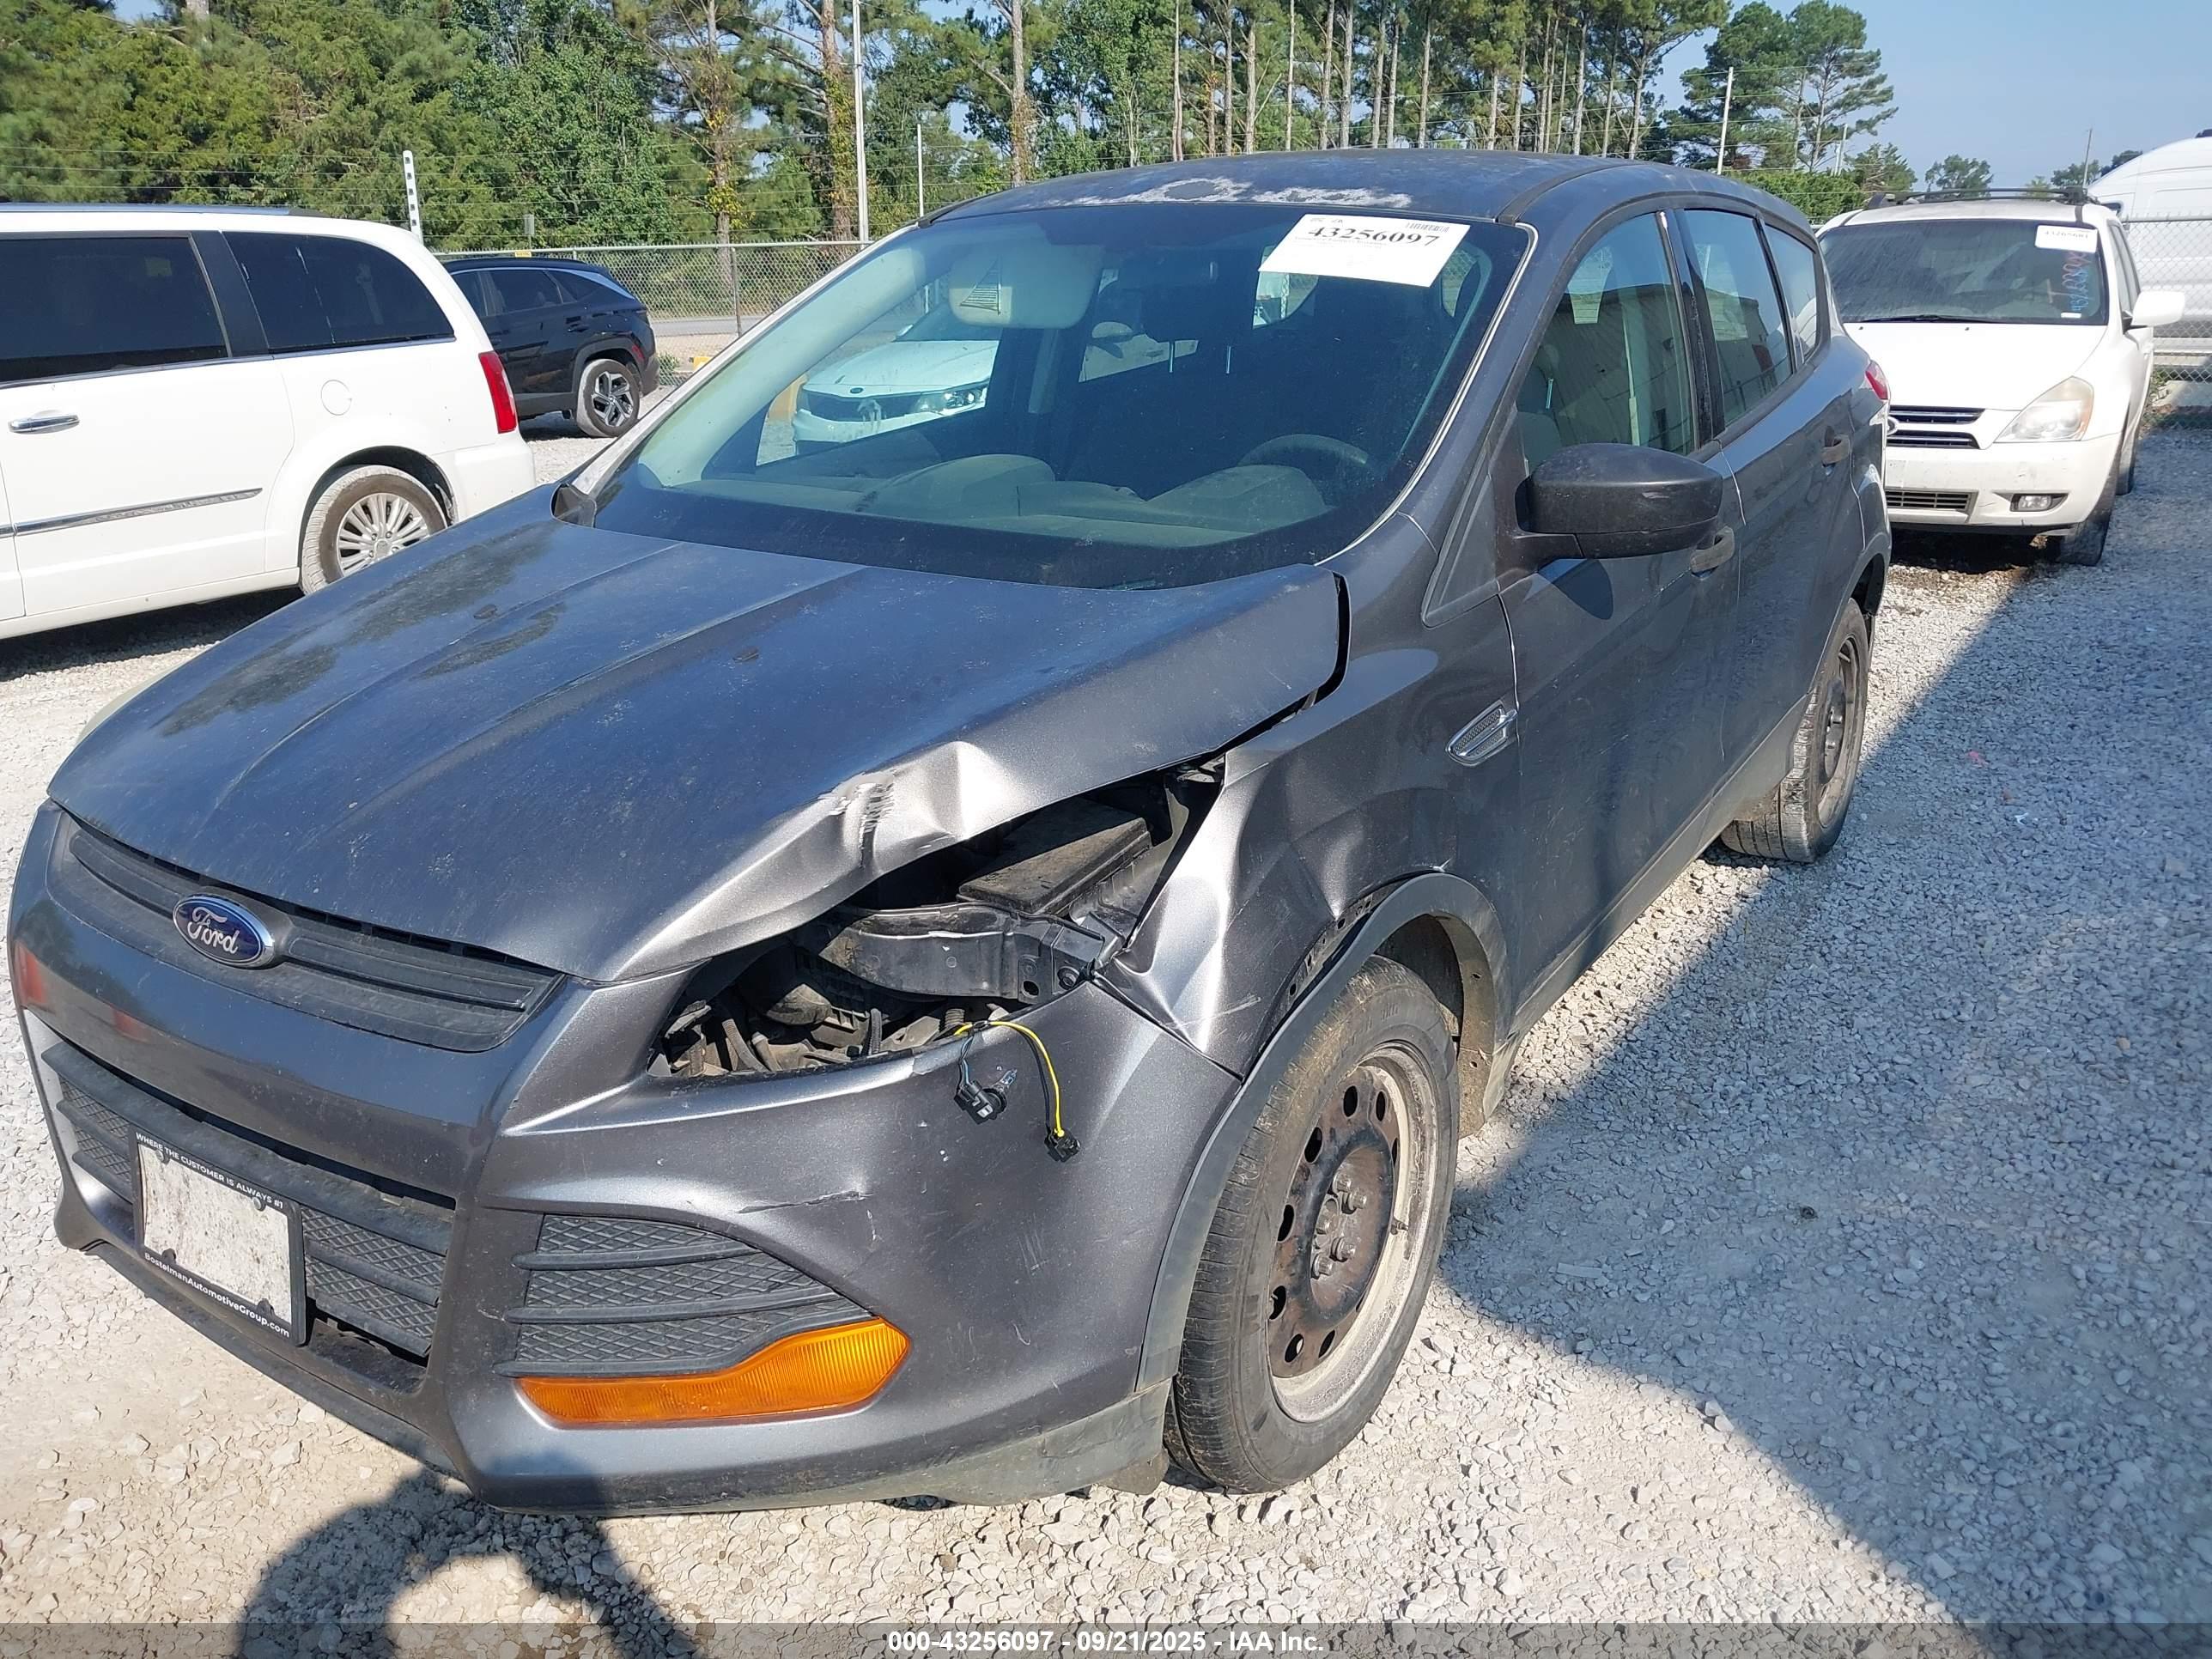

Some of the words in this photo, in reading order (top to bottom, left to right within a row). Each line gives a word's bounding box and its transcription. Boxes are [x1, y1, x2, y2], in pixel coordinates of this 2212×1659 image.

[1308, 226, 1440, 246] 43256097
[187, 906, 241, 954] Ford
[136, 1132, 164, 1152] WHERE
[164, 1146, 179, 1160] THE
[180, 1156, 225, 1182] CUSTOMER
[226, 1177, 234, 1187] IS
[236, 1182, 272, 1203] ALWAYS
[274, 1199, 283, 1209] #1
[144, 1252, 290, 1339] BostelmanAutomotiveGroup.com
